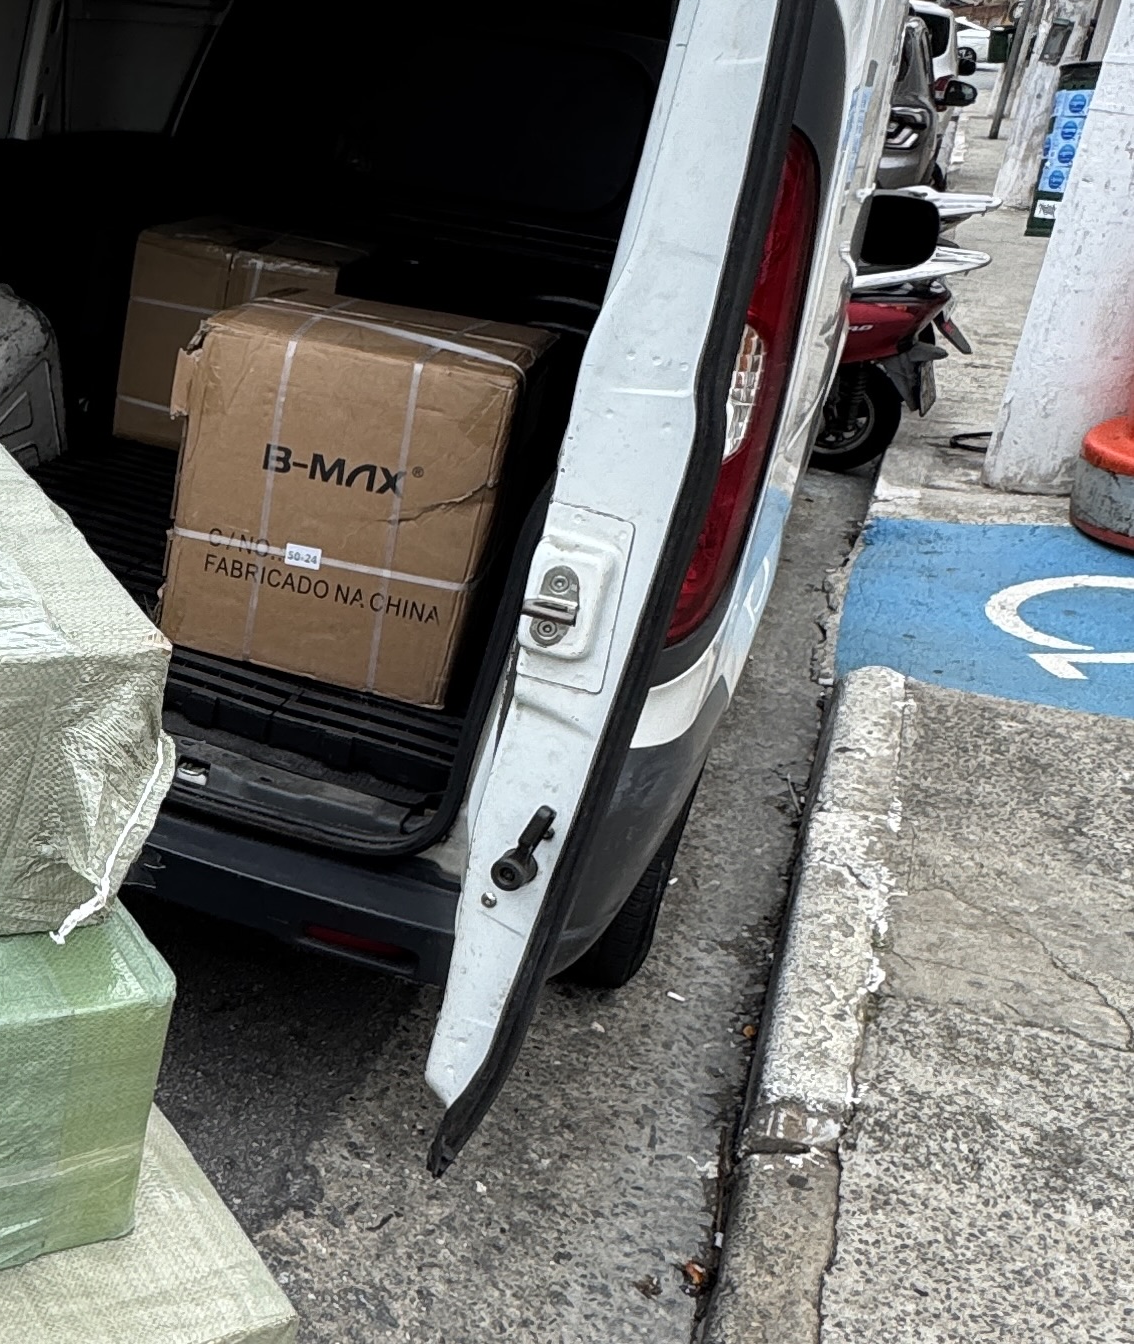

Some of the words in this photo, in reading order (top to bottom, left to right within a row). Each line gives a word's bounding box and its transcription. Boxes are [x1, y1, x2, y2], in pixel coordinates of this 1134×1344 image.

[262, 443, 407, 499] B-MAX
[204, 554, 329, 599] FABRICADO
[334, 583, 364, 609] NA
[369, 592, 441, 627] CHINA
